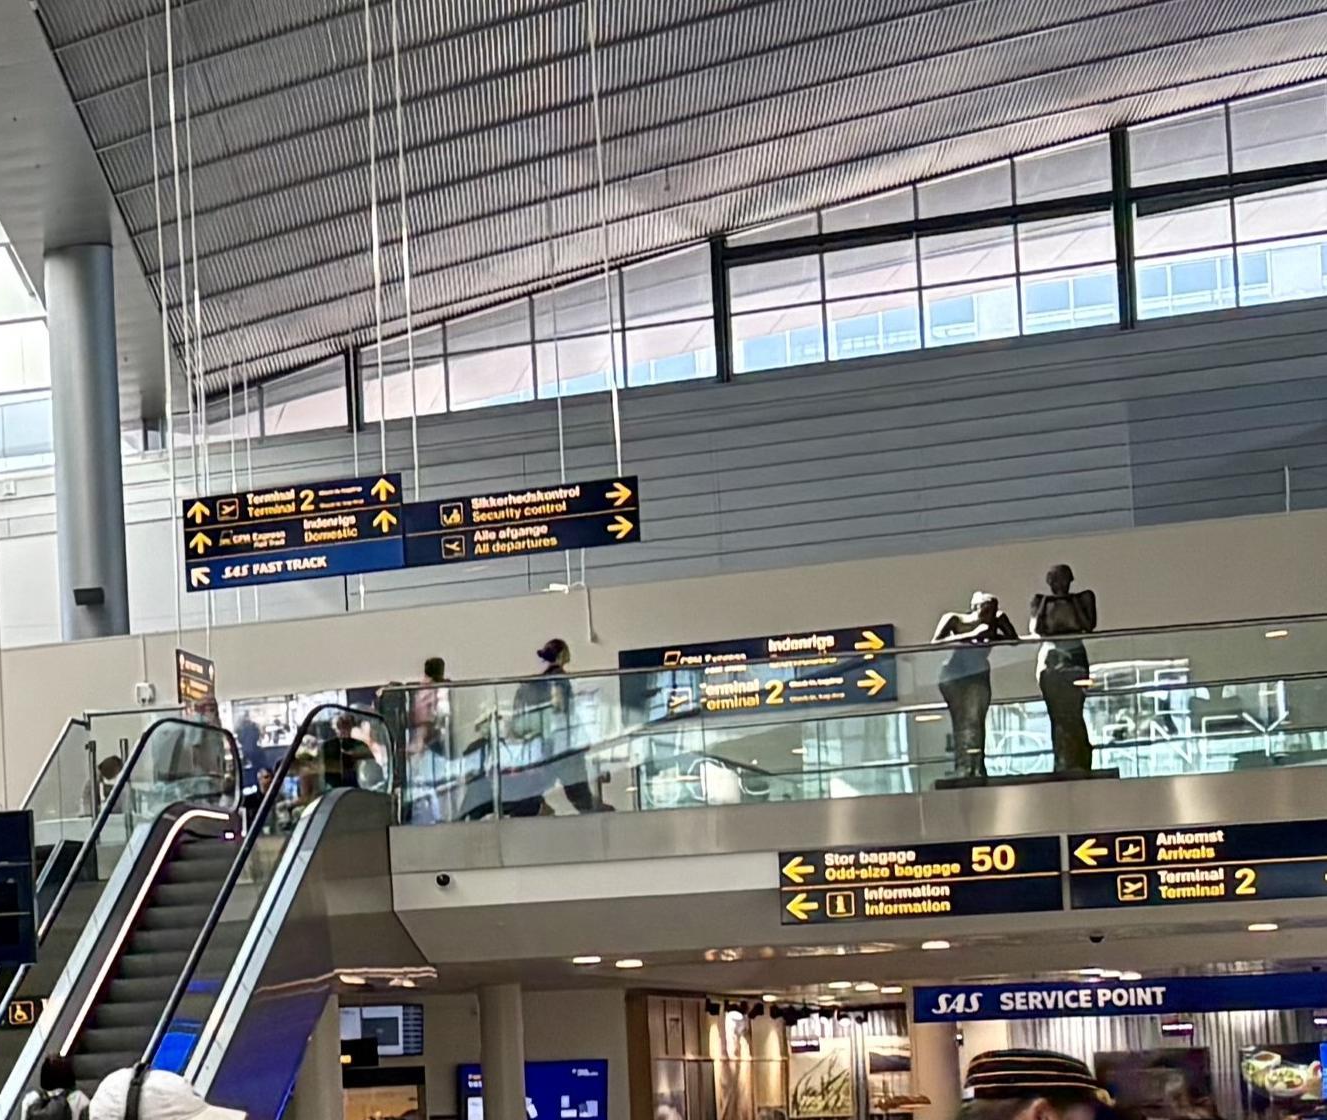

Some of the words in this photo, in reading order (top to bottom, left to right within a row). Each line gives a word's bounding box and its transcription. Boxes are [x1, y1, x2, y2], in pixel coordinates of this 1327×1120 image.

[246, 488, 296, 505] Terminal
[299, 489, 315, 512] 2
[471, 485, 581, 510] Sikkerhedskontrol
[247, 502, 296, 518] Terminal
[472, 506, 522, 524] Security
[524, 501, 567, 515] control
[303, 515, 356, 530] Indenrigs
[498, 523, 549, 540] afgange
[305, 528, 358, 543] Domestic
[474, 541, 490, 556] All
[492, 536, 558, 555] departures
[252, 559, 283, 575] FAST
[285, 555, 327, 572] TRACK
[764, 678, 784, 705] 2
[1156, 830, 1224, 846] Ankomst
[824, 853, 855, 866] Stor
[859, 850, 916, 866] bagage
[971, 844, 1016, 872] 50
[1157, 845, 1215, 861] Arrivals
[825, 865, 890, 881] Odd-size
[895, 861, 961, 879] baggage
[1158, 868, 1224, 884] Terminal
[1234, 868, 1256, 895] 2
[1159, 883, 1225, 900] Terminal
[864, 884, 950, 901] Information
[865, 899, 951, 916] Information
[932, 992, 983, 1014] SAS
[1000, 989, 1093, 1011] SERVICE
[1097, 986, 1166, 1007] POINT
